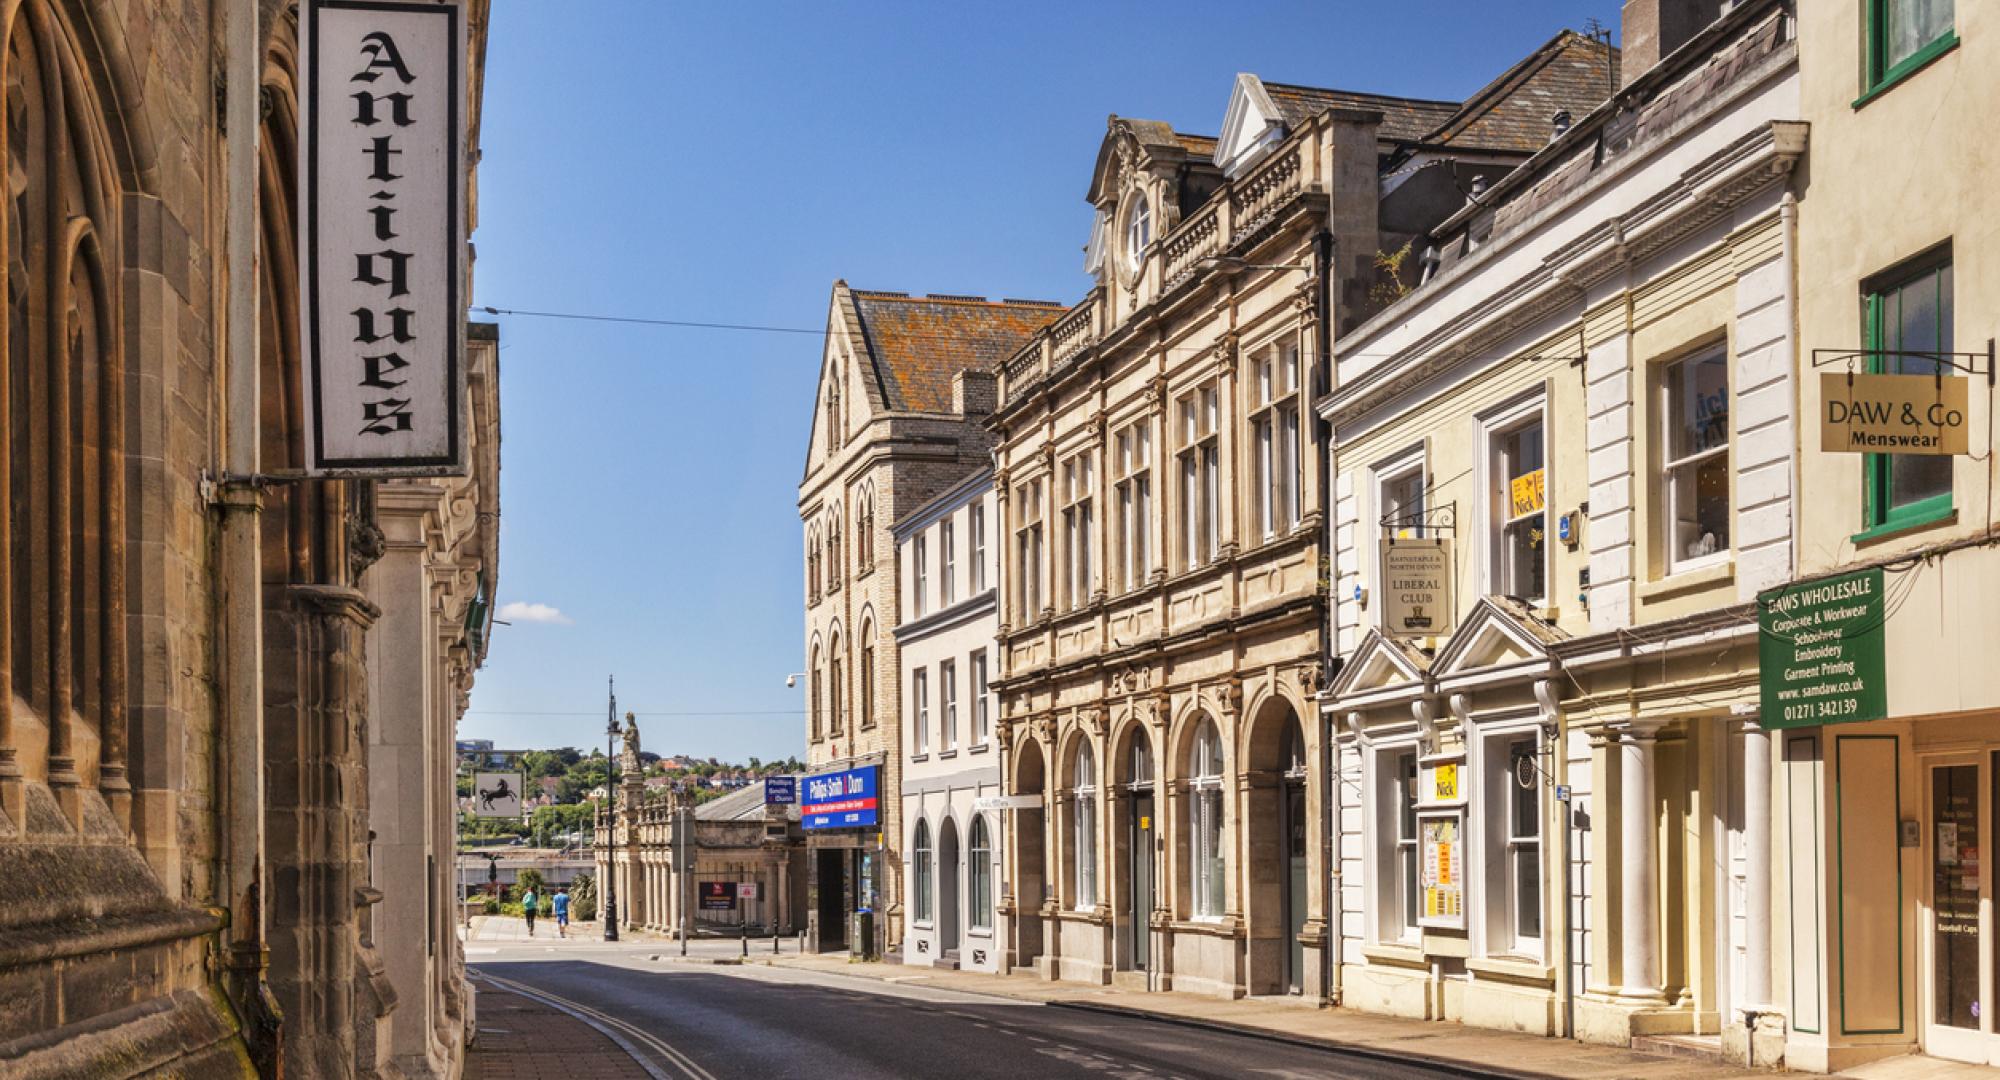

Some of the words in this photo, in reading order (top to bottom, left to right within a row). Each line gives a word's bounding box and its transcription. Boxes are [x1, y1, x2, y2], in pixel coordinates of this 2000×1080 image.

[350, 31, 417, 436] Antiques
[1828, 400, 1892, 425] DAW
[1900, 402, 1923, 426] &
[1927, 403, 1962, 427] Co
[1851, 431, 1939, 447] Menswear
[1516, 495, 1534, 515] Nick
[1392, 579, 1440, 590] LIBERAL
[1401, 593, 1433, 604] CLUB
[1768, 593, 1799, 614] DAWS
[1801, 577, 1871, 607] WHOLESALE
[1772, 615, 1812, 633] Corporate
[1814, 612, 1822, 624] &
[1823, 605, 1867, 621] Workwear
[1794, 628, 1842, 646] Schoolwear
[1795, 645, 1842, 662] Embroidery
[1784, 666, 1819, 681] Garment
[1821, 661, 1855, 676] Printing
[1784, 703, 1814, 720] 01271
[1818, 699, 1857, 717] 342139
[848, 774, 864, 794] Dunn
[1437, 781, 1454, 797] Nick
